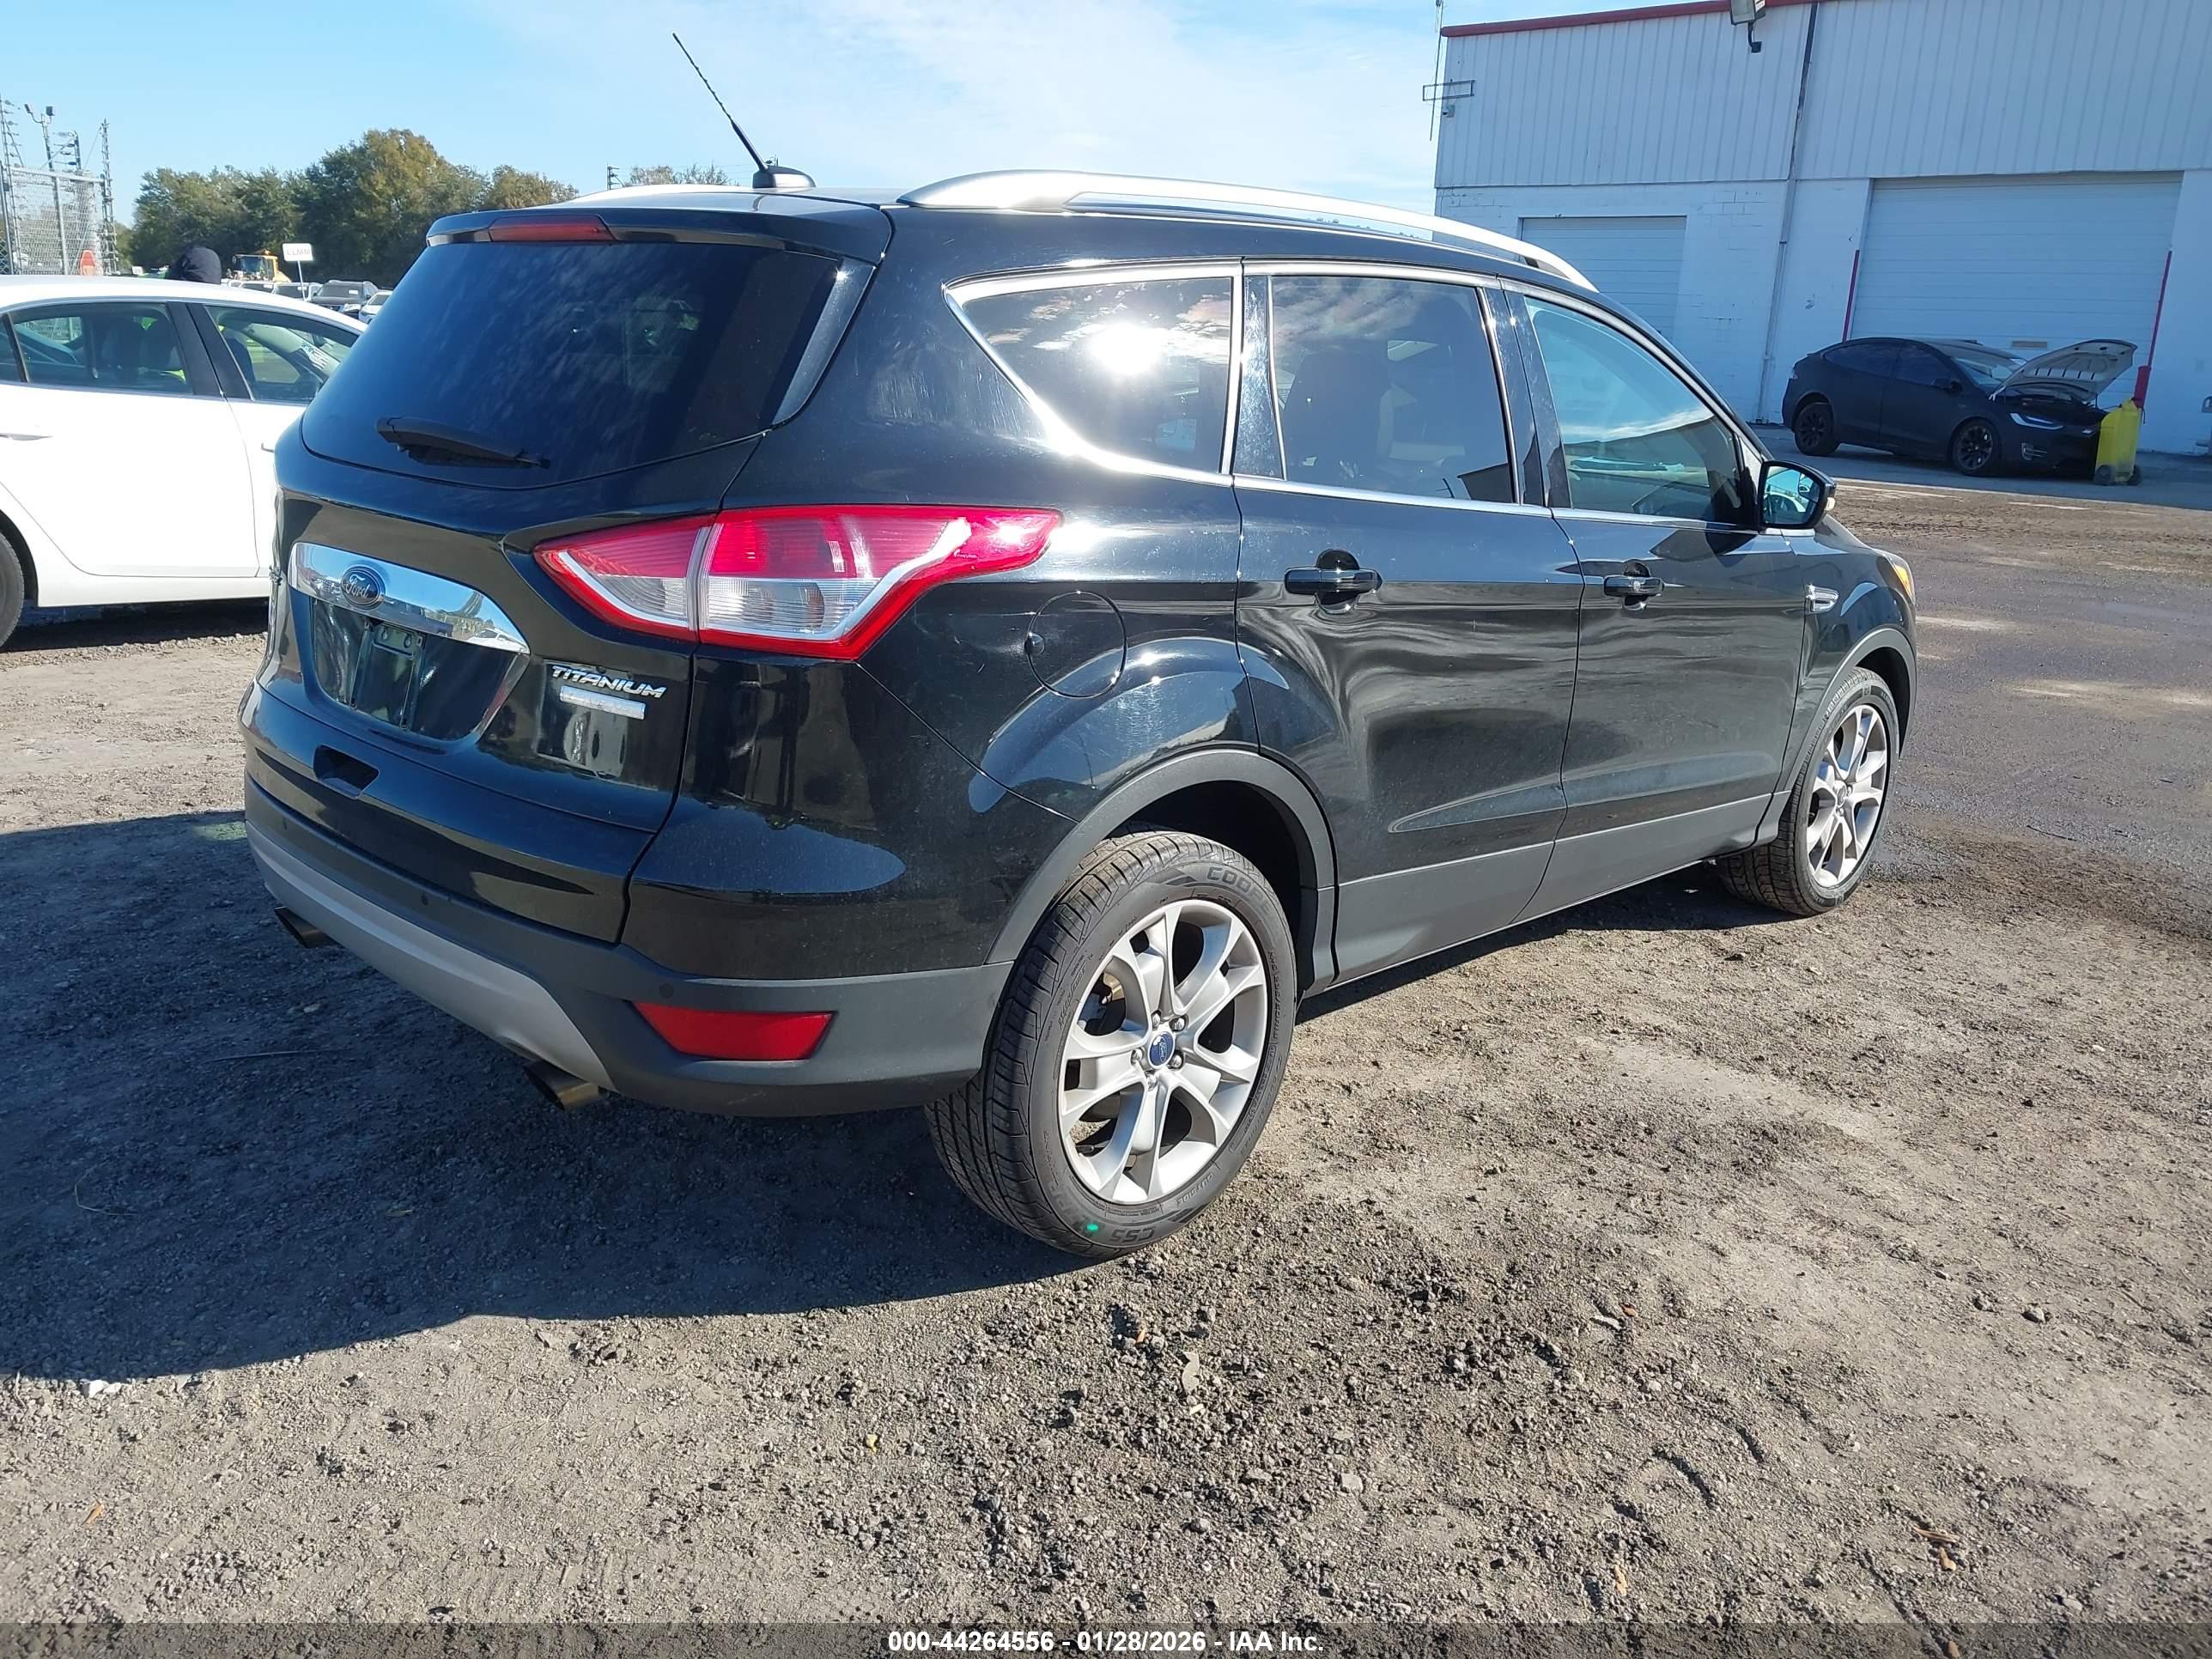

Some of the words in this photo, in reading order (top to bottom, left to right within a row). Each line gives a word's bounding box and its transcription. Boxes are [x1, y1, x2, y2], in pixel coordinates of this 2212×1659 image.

[346, 574, 371, 599] Ford
[551, 665, 667, 698] TITANIUM
[1109, 1226, 1155, 1243] CS5
